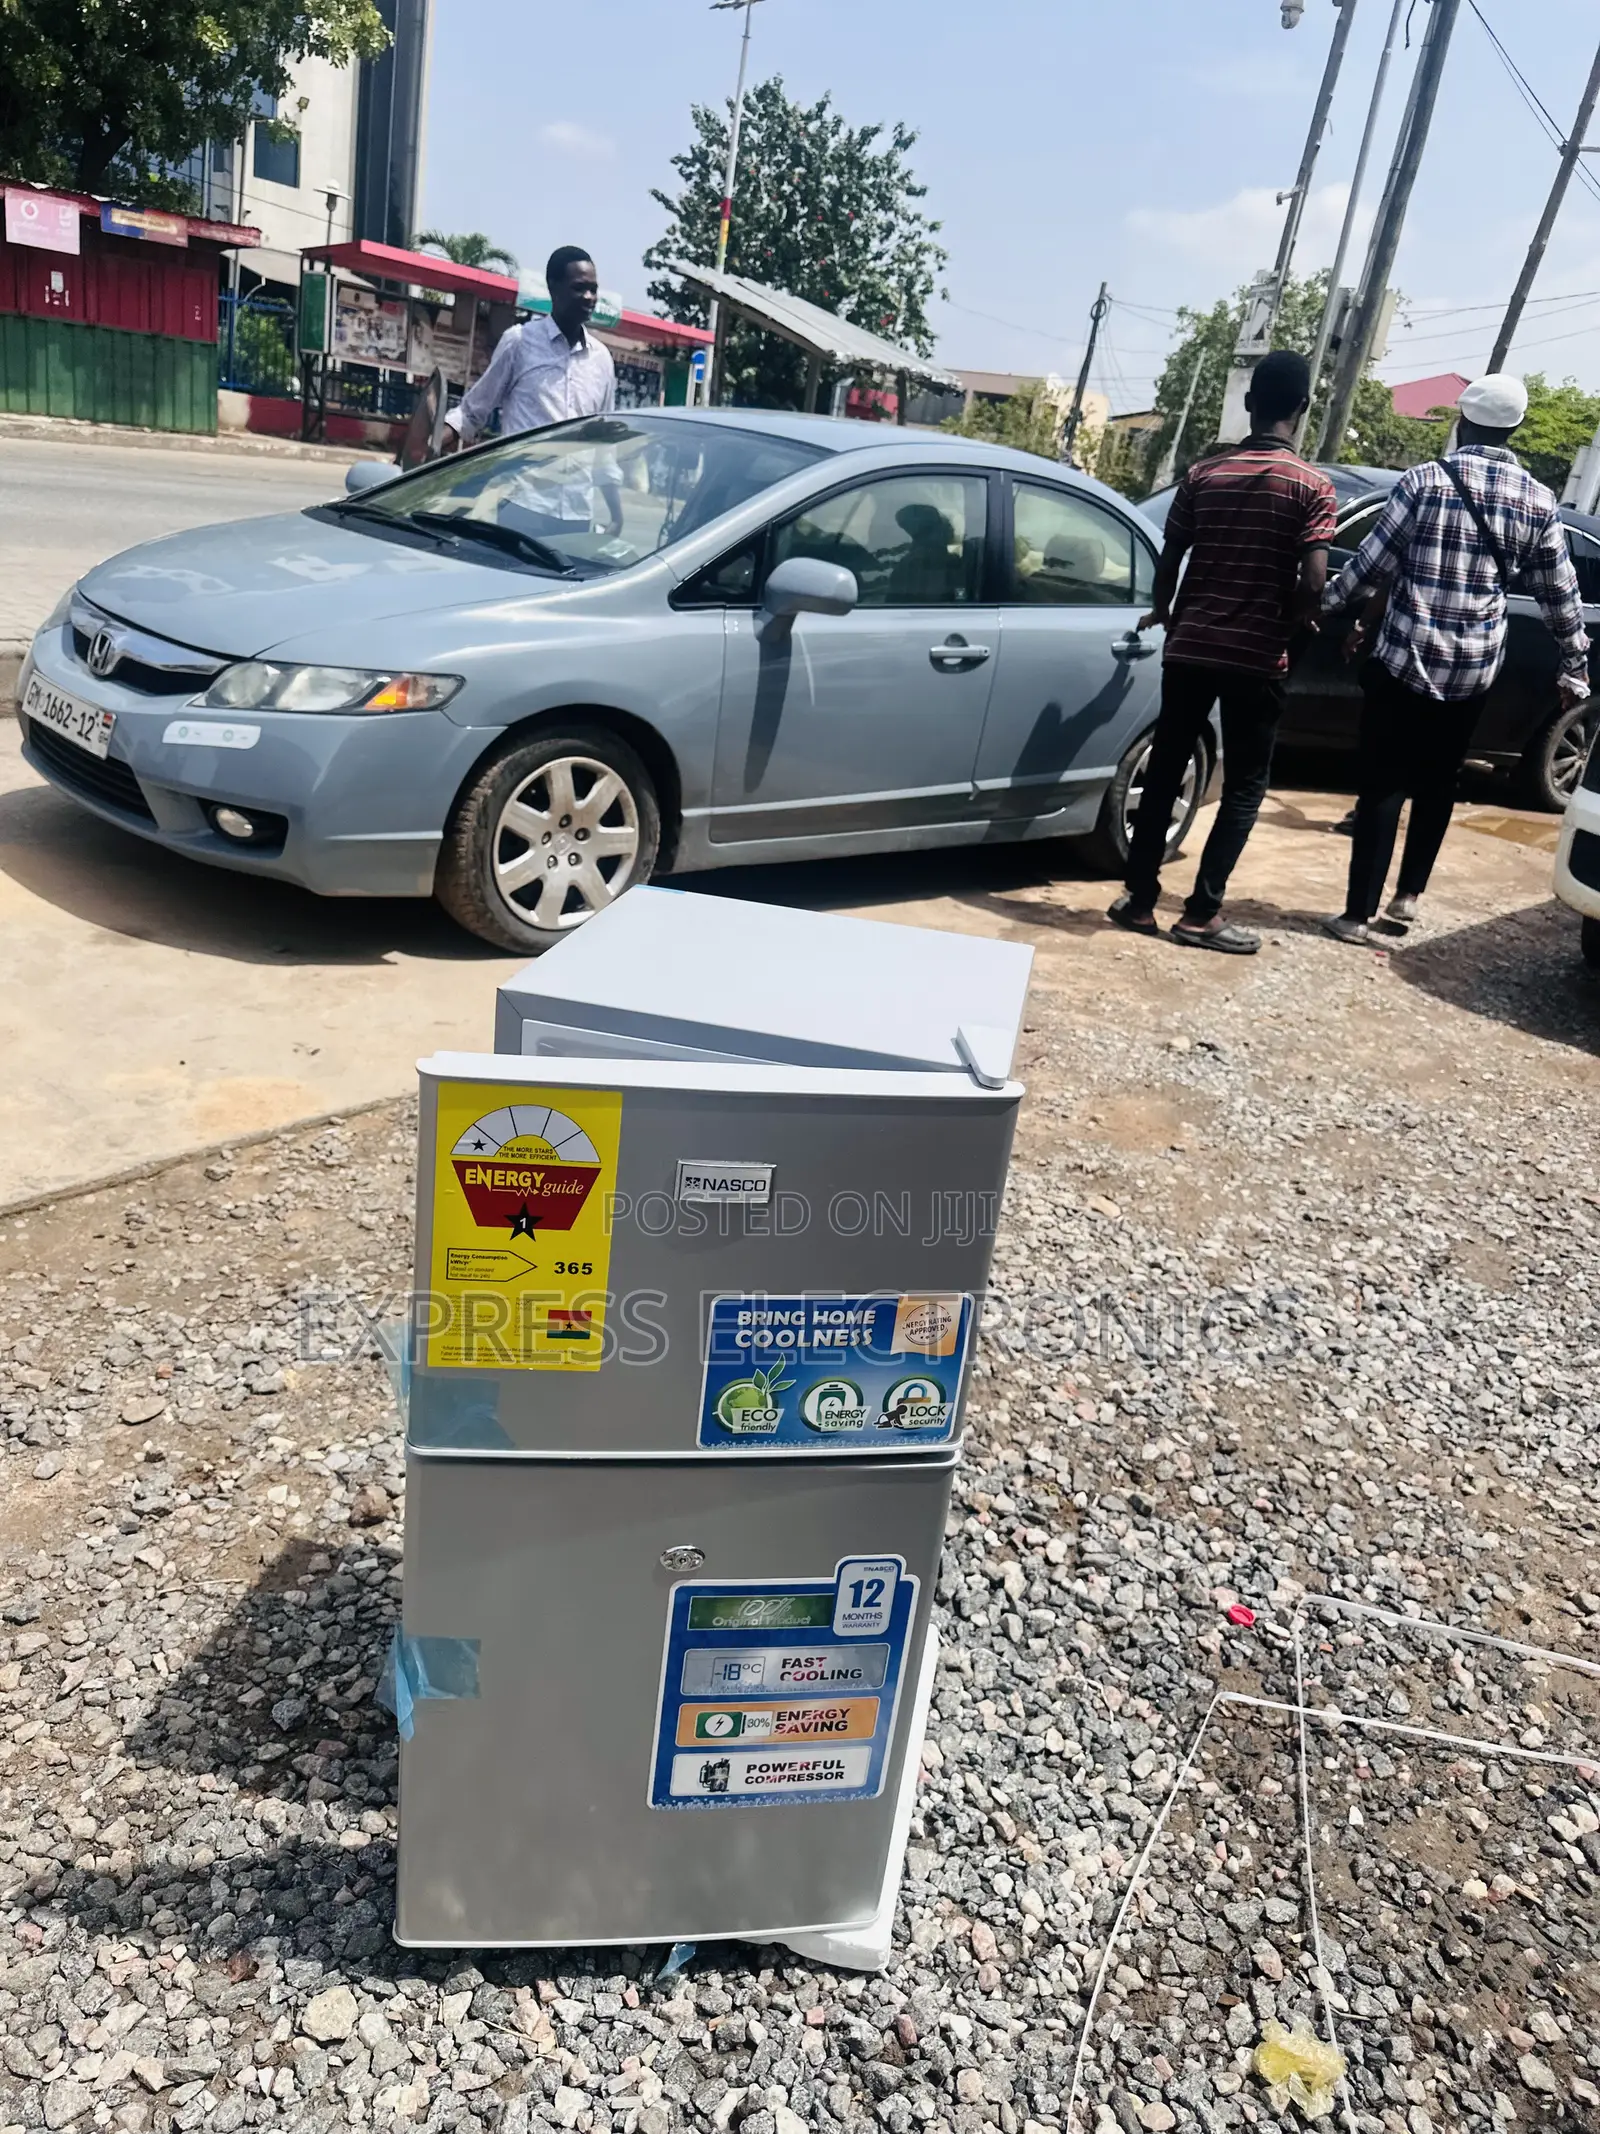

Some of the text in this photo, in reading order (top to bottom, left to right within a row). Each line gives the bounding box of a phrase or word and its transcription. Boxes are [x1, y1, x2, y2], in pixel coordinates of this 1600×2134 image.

[43, 692, 96, 742] 1662-12
[465, 1164, 584, 1197] ENERGY guide
[702, 1178, 767, 1191] NASCO
[519, 1217, 526, 1229] 1
[554, 1261, 593, 1275] 365
[737, 1310, 876, 1326] BRING HOME
[902, 1315, 952, 1330] NERGY RATING
[910, 1324, 945, 1336] APPROVED
[735, 1328, 873, 1348] COOLNESS
[741, 1409, 778, 1422] ECO
[825, 1409, 866, 1419] ENERGY
[910, 1405, 946, 1417] LOCK
[741, 1422, 776, 1432] friendly
[825, 1419, 863, 1428] saving
[908, 1417, 945, 1426] security
[849, 1578, 885, 1608] 12
[738, 1597, 795, 1617] 100%
[712, 1615, 811, 1628] Original Product
[842, 1612, 883, 1621] MONTHS
[781, 1656, 827, 1669] FAST
[780, 1669, 862, 1682] COOLING
[776, 1708, 851, 1722] ENERGY
[774, 1720, 849, 1734] SAVING
[746, 1759, 846, 1774] POWERFUL
[744, 1772, 845, 1785] COMPRESSOR
